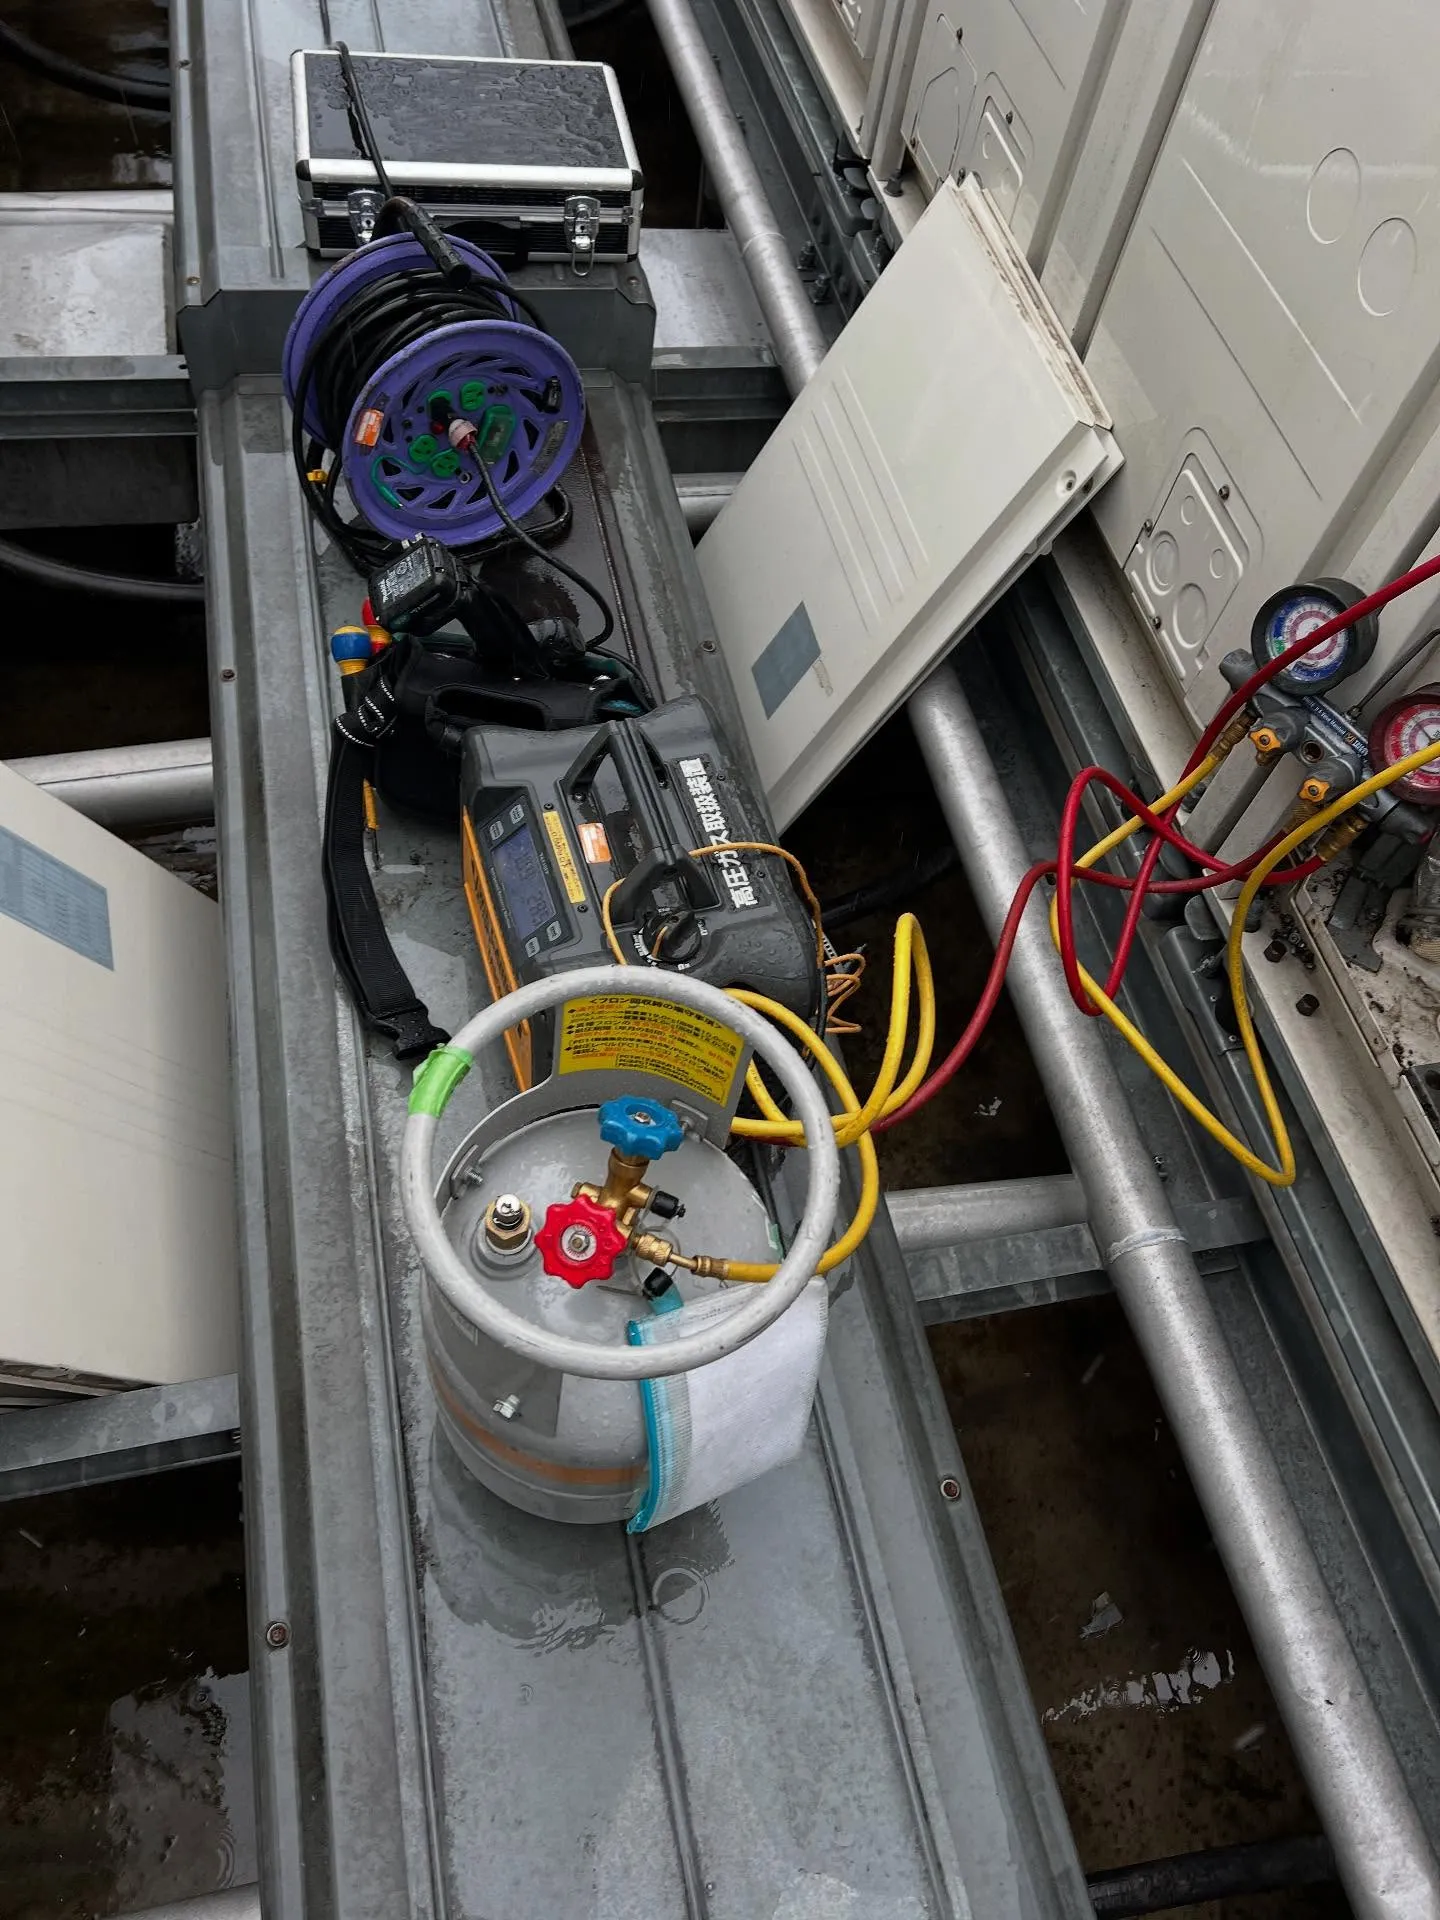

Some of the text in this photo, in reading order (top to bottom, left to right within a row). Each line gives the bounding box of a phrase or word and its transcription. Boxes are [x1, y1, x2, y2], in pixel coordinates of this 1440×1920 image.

[678, 757, 759, 909] 高圧ガス取扱装置
